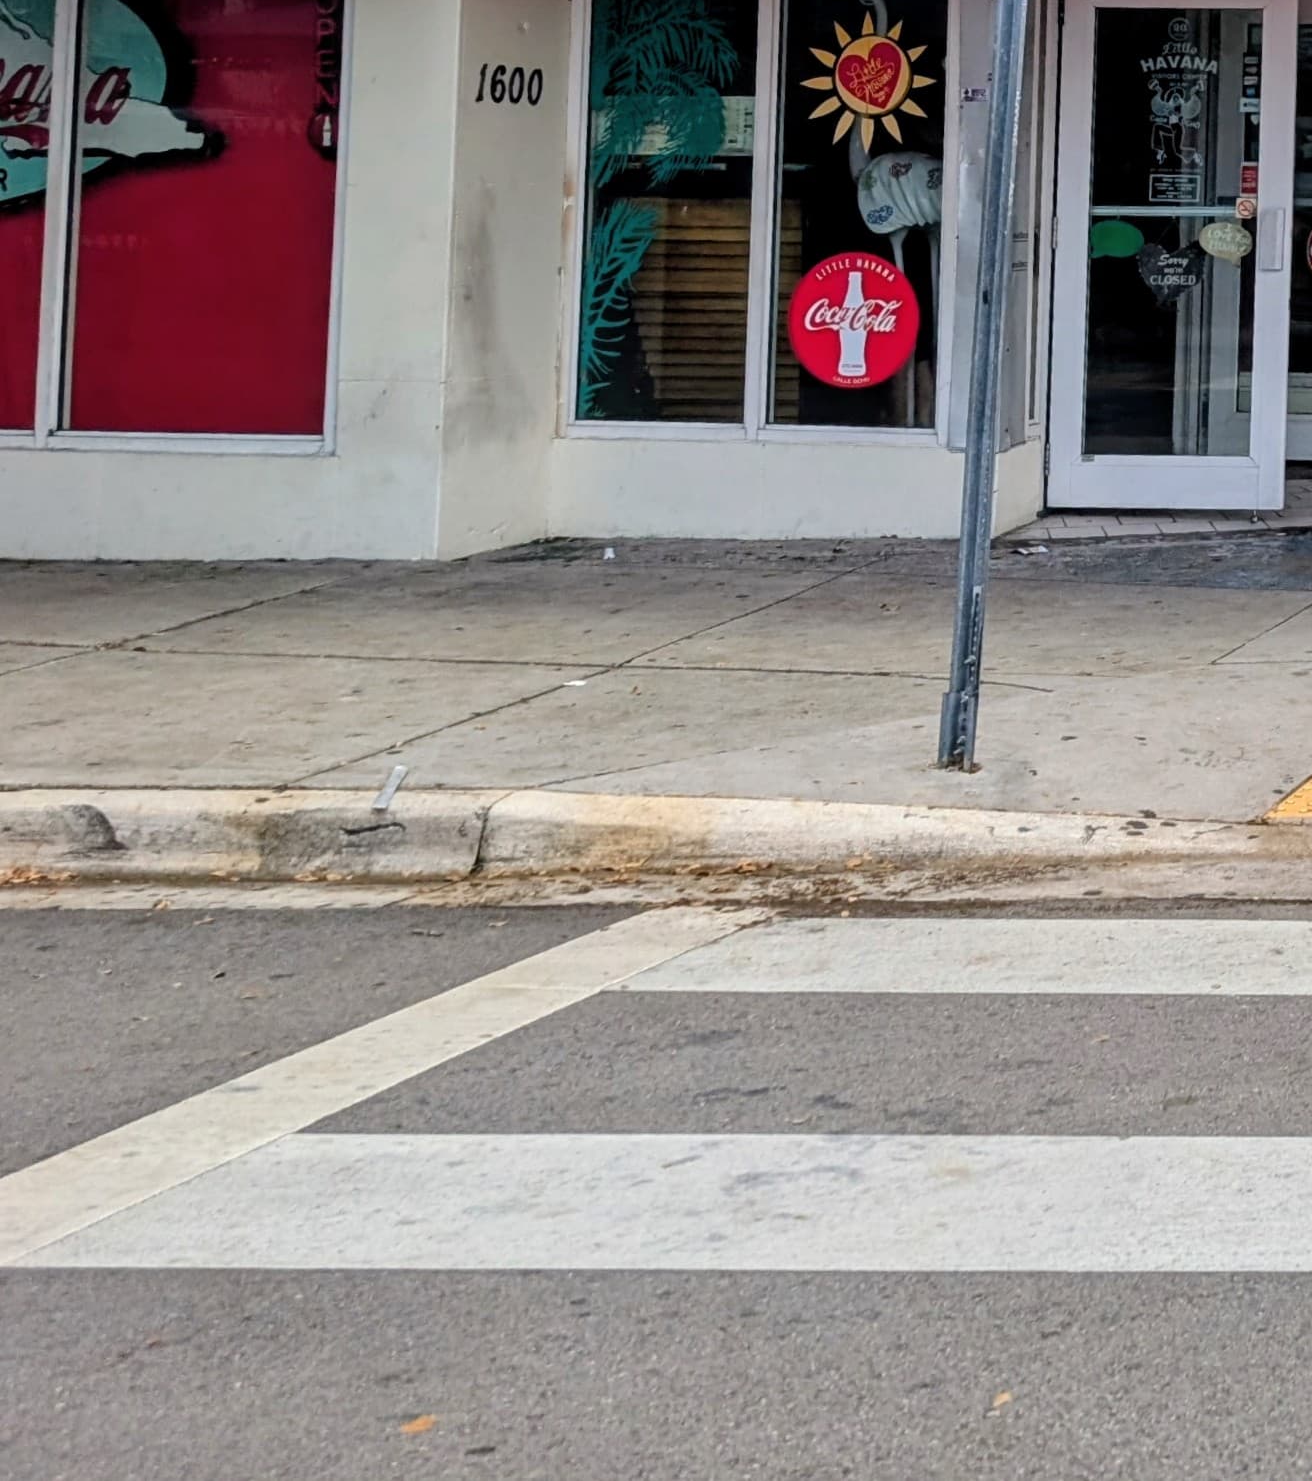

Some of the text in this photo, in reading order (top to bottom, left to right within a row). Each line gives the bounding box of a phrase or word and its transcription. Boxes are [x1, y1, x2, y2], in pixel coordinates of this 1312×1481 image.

[1140, 55, 1218, 74] HAVANA
[475, 63, 543, 106] 1600
[815, 258, 895, 282] LITTLE HAVANA
[1157, 254, 1190, 268] Sorry
[1150, 275, 1197, 286] CLOSED
[804, 298, 903, 332] Coca-Cola
